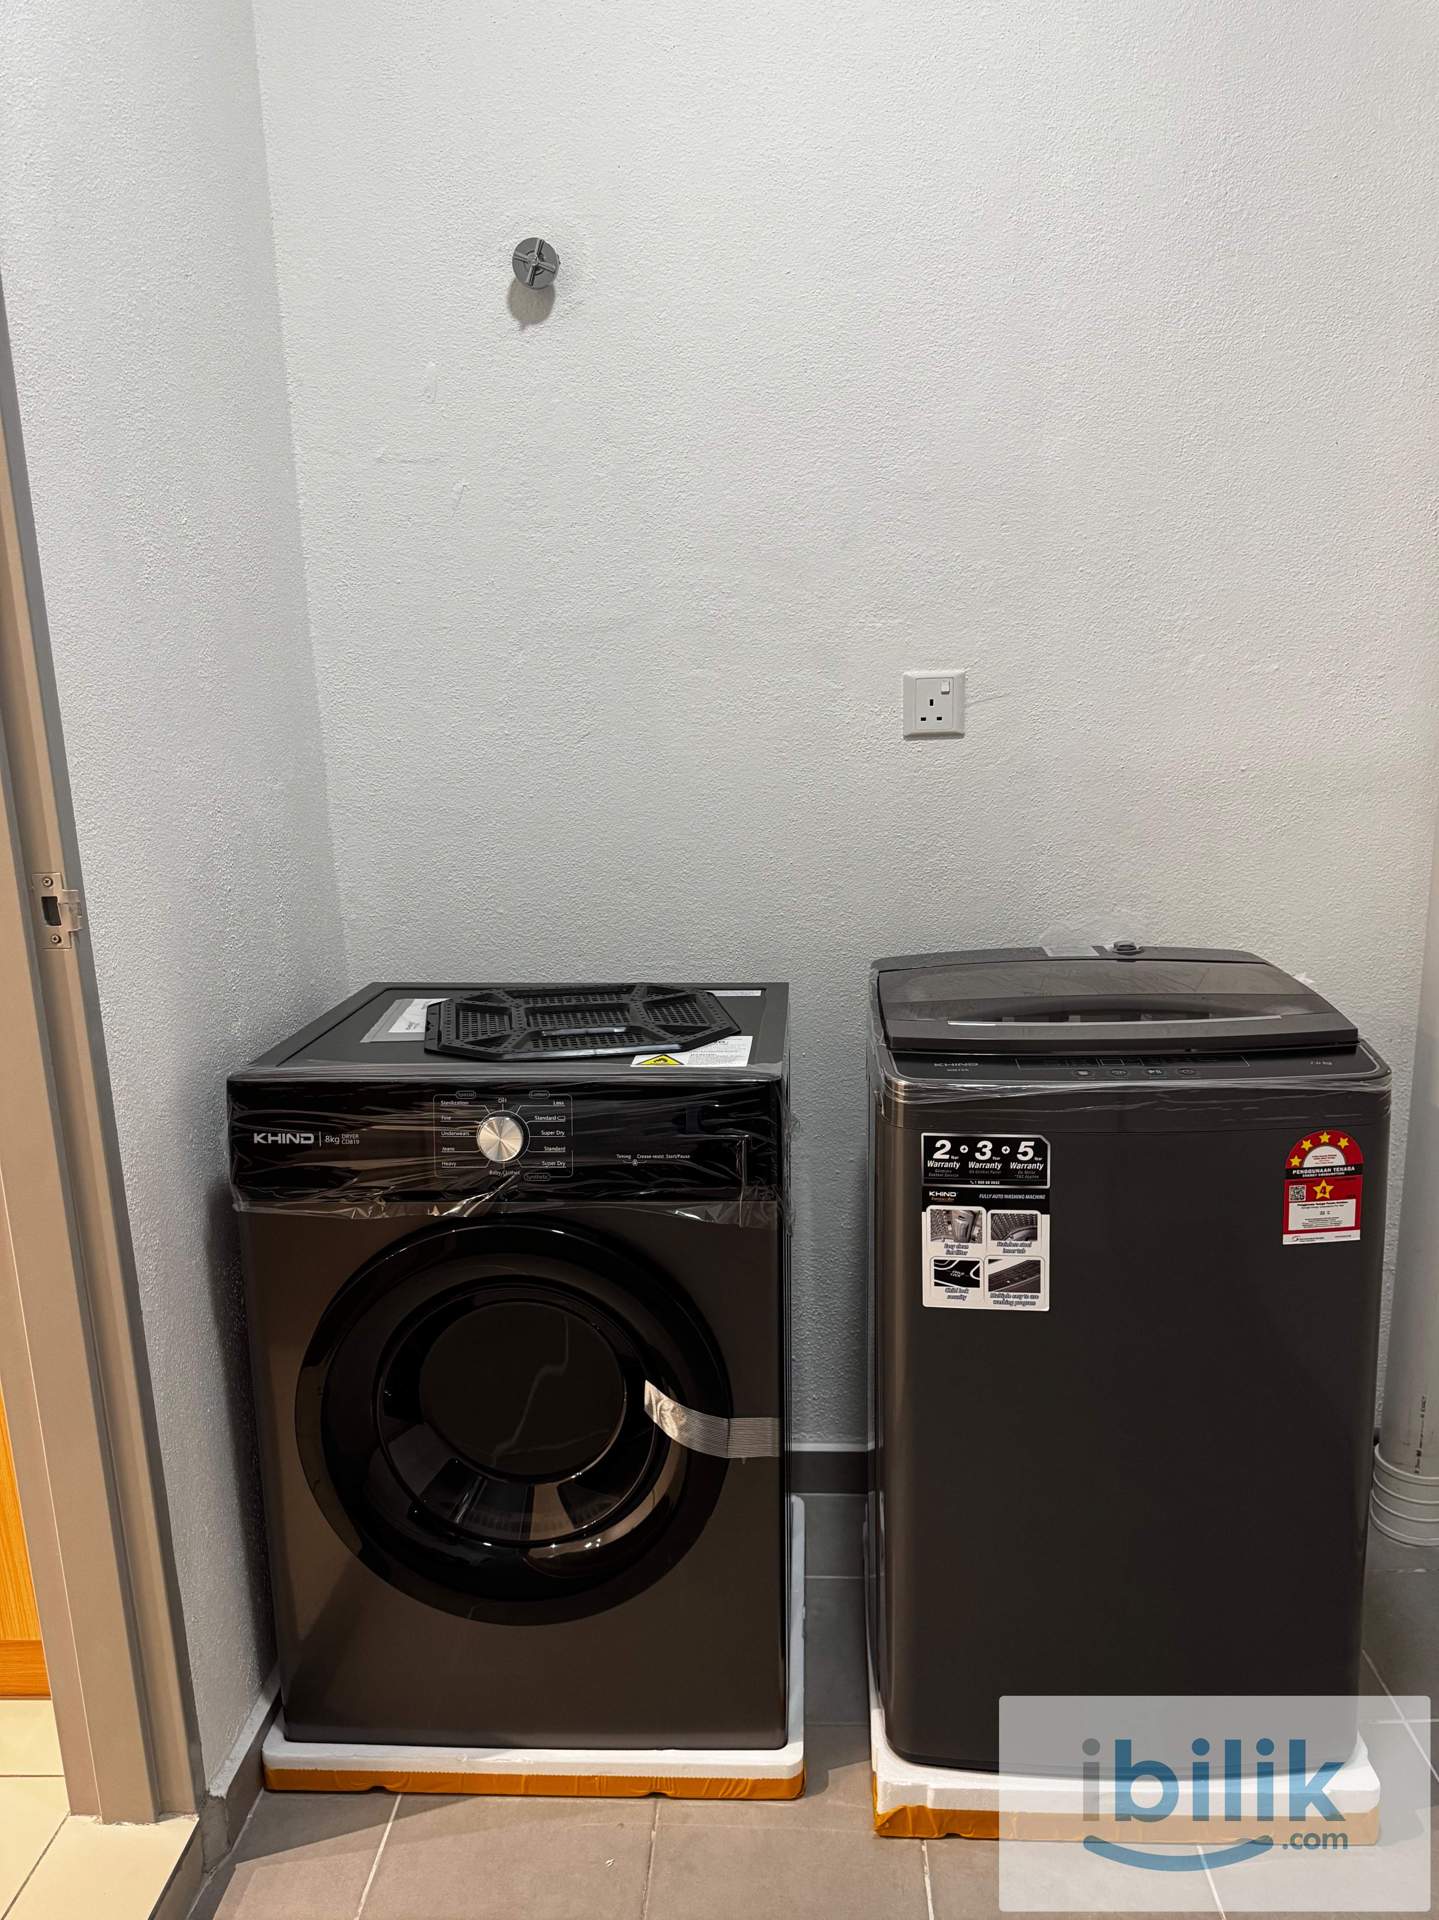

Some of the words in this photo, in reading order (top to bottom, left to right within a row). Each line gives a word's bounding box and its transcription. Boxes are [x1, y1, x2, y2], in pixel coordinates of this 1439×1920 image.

[254, 1133, 314, 1144] KHIND
[325, 1135, 340, 1145] 8kg
[933, 1140, 951, 1159] 2
[975, 1140, 993, 1160] 3
[1017, 1141, 1035, 1161] 5
[927, 1160, 960, 1170] Warranty
[968, 1161, 1002, 1170] Warranty
[1010, 1162, 1044, 1170] Warranty
